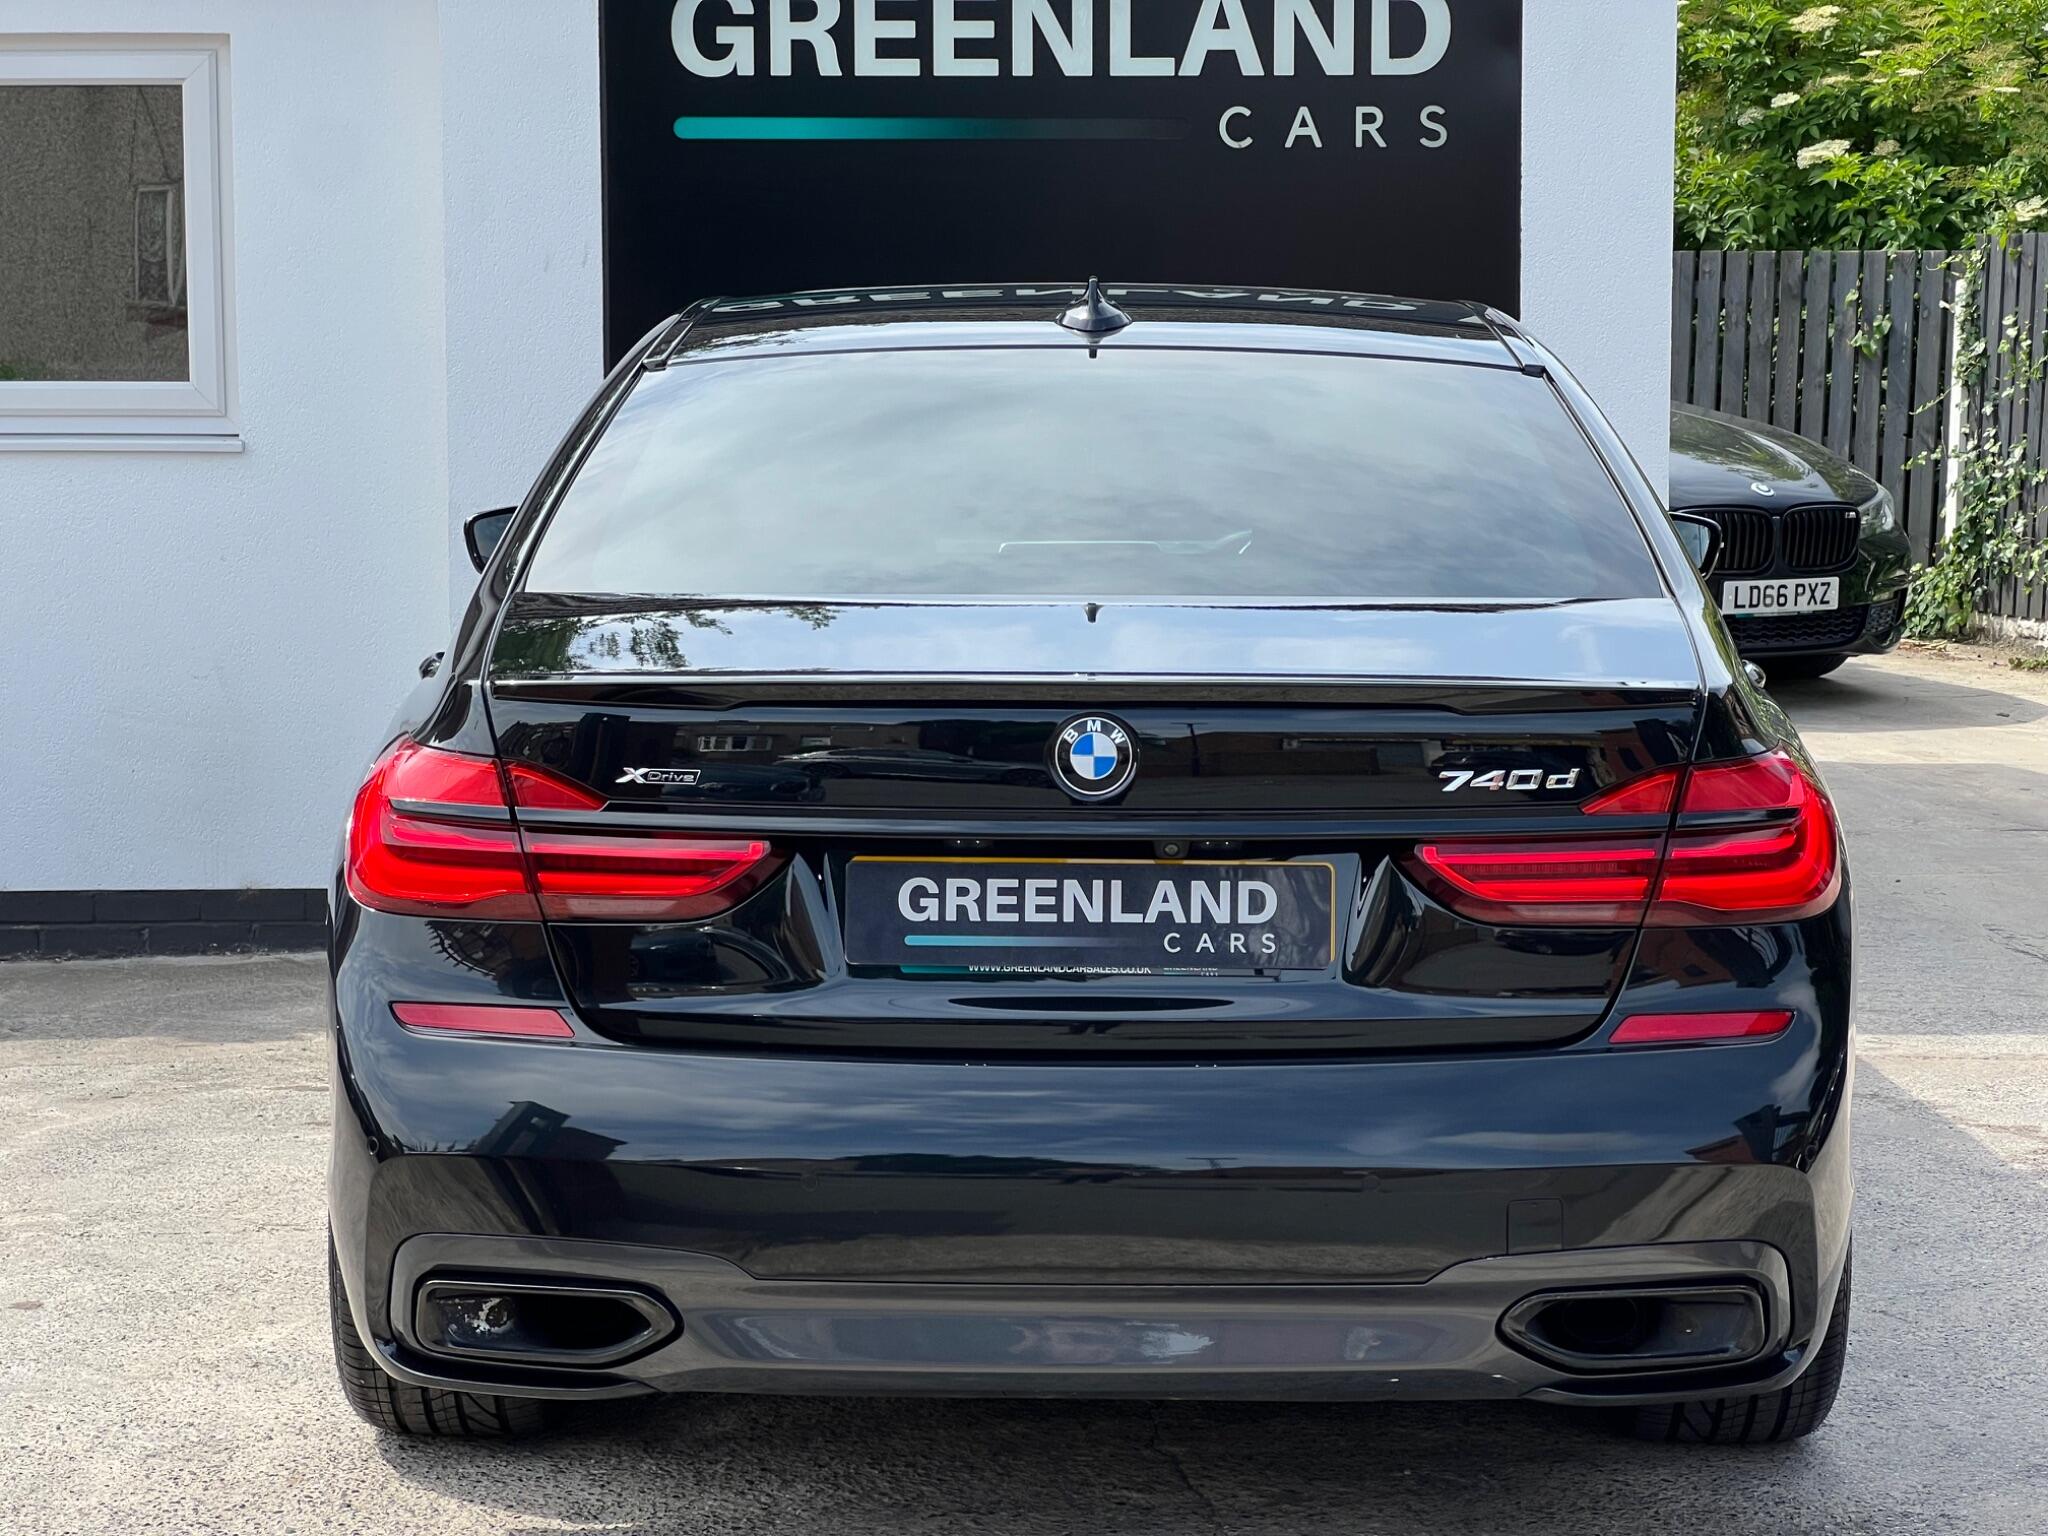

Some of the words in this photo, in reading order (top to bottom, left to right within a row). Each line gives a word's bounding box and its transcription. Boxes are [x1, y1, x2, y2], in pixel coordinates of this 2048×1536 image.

[670, 0, 1453, 77] GREENLAND
[1218, 105, 1449, 149] CARS
[1733, 584, 1788, 609] LD66
[1794, 582, 1831, 607] PXZ
[1063, 719, 1126, 745] BMW
[1438, 768, 1581, 792] 740d
[897, 876, 1279, 925] GREENLAND
[1163, 932, 1277, 954] CARS
